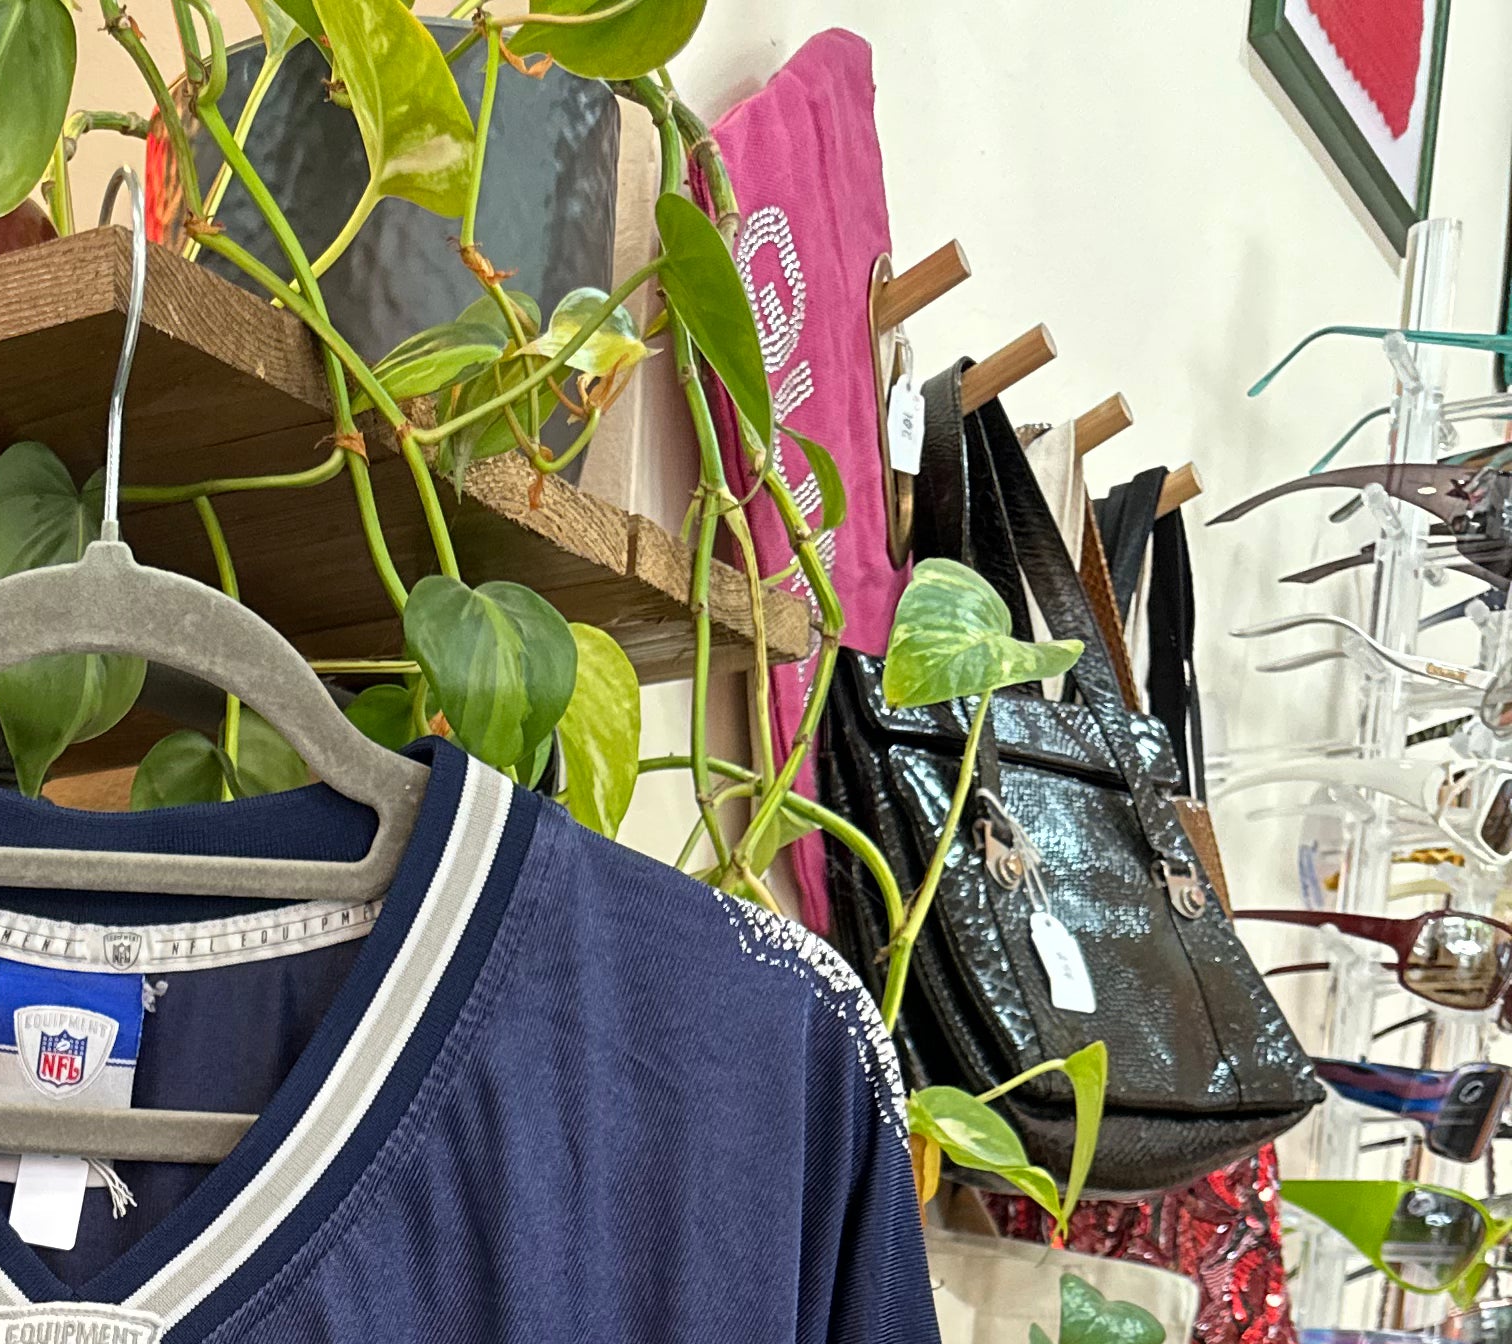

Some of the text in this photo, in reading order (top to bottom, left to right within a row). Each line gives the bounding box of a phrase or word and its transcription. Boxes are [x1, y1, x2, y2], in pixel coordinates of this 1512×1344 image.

[171, 905, 371, 956] NFL EQUIPME
[23, 1011, 109, 1039] EQUIPMENT
[41, 1052, 81, 1082] NFL
